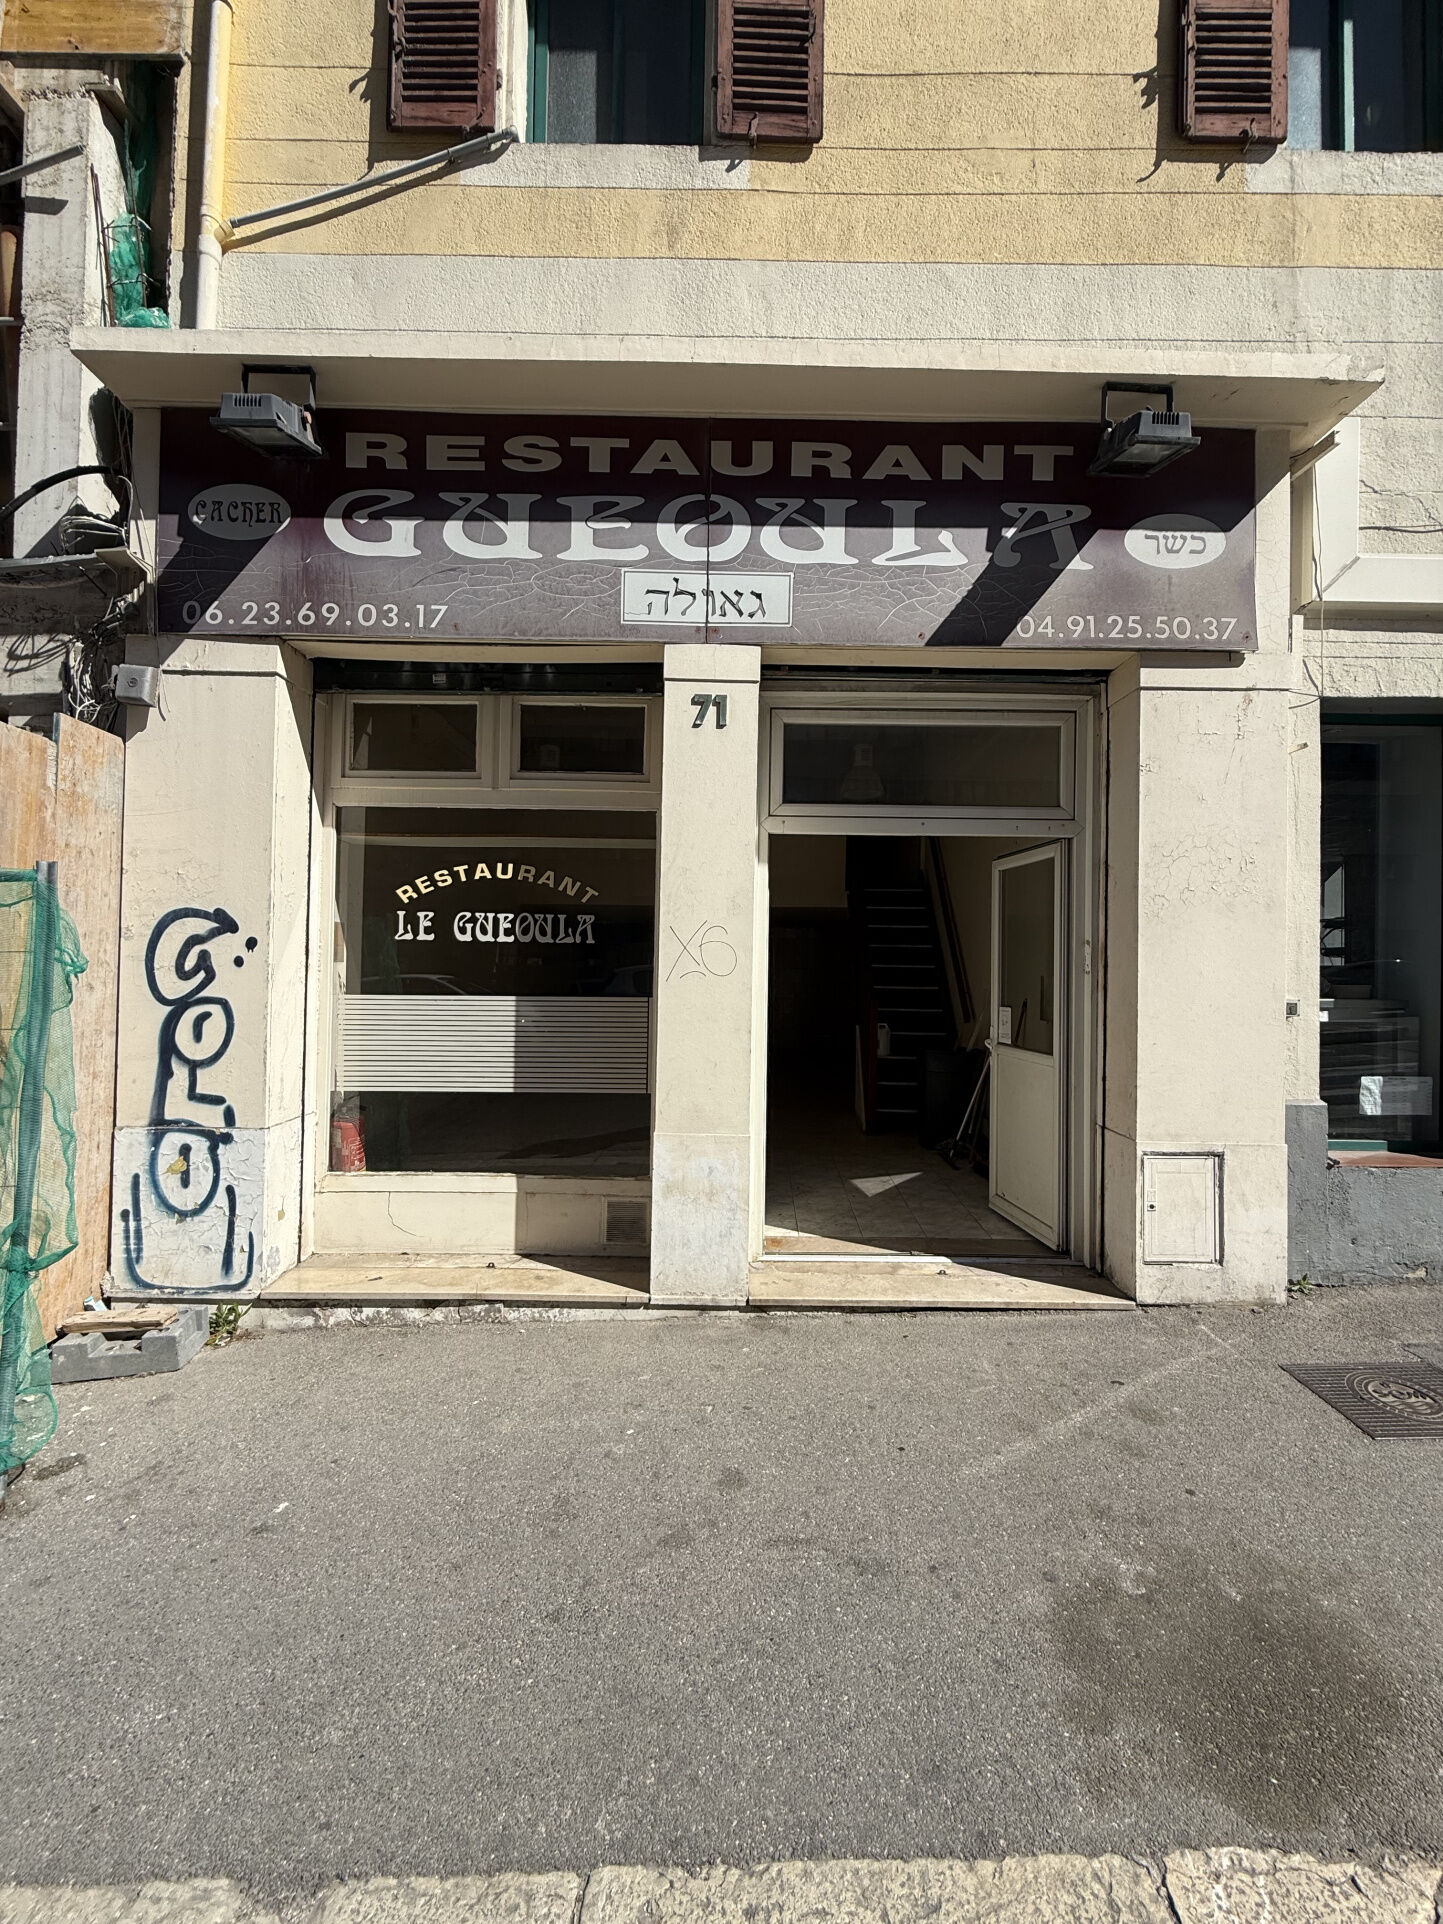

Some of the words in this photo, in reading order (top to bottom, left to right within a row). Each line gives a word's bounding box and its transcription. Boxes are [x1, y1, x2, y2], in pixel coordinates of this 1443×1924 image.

[345, 432, 1074, 482] RESTAURANT
[195, 500, 284, 528] CACHER
[324, 488, 1094, 571] GUEOULA
[1144, 533, 1207, 555] כשר
[182, 600, 449, 629] 06.23.69.03.17
[645, 577, 767, 618] גאולה
[1016, 614, 1239, 641] 04.91.25.50.37
[690, 693, 728, 730] 71
[395, 862, 601, 904] RESTAURANT
[394, 910, 435, 942] LE
[453, 911, 597, 944] GUEOULA
